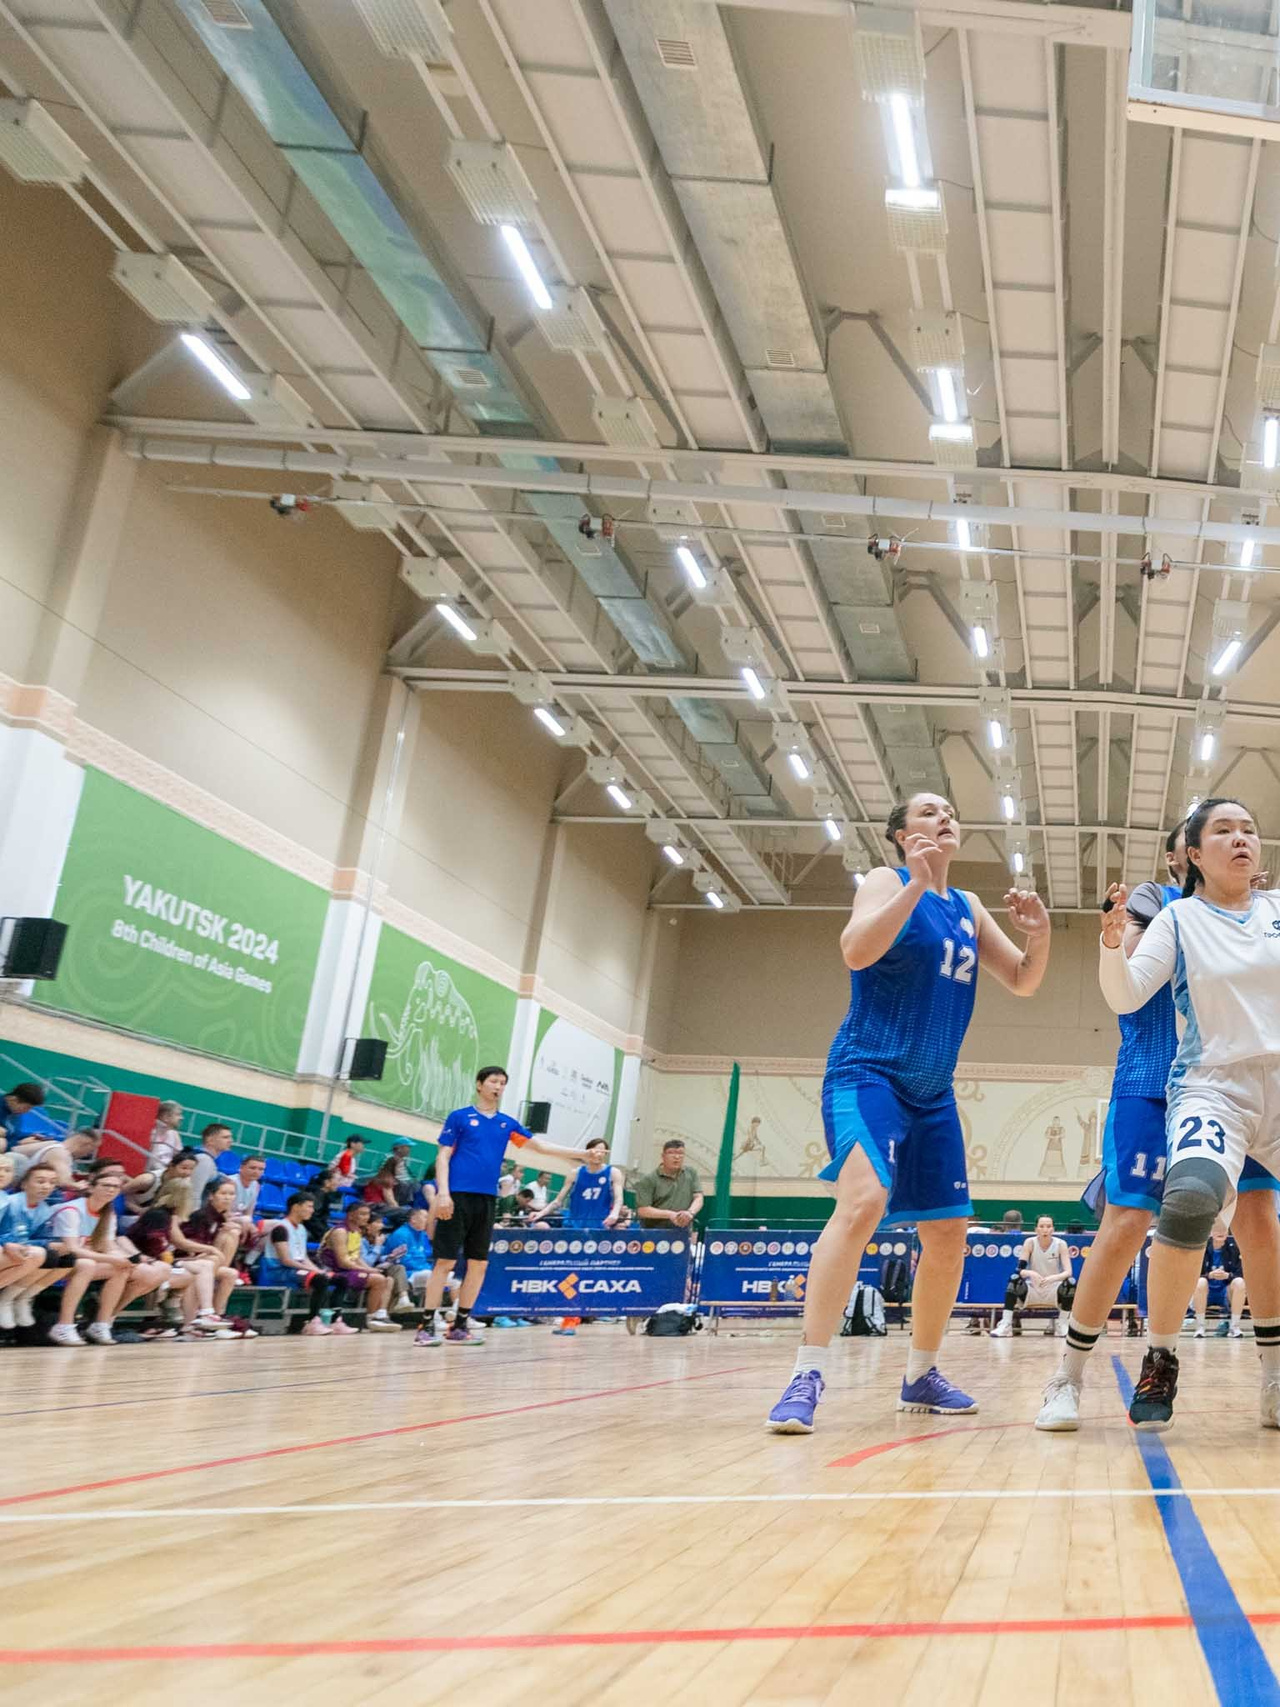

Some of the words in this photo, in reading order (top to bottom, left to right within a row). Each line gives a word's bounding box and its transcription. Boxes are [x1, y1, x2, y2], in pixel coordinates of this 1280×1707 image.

[123, 874, 229, 944] YAKUTSK
[227, 923, 280, 965] 2024
[111, 919, 138, 944] 8th
[139, 930, 194, 965] Children
[193, 953, 210, 970] of
[207, 957, 234, 980] Asia
[234, 967, 273, 994] Games
[939, 937, 976, 985] 12
[1176, 1116, 1226, 1155] 23
[1131, 1152, 1167, 1181] 11
[582, 1187, 603, 1200] 47
[511, 1280, 558, 1293] НВК
[579, 1280, 642, 1293] САХА
